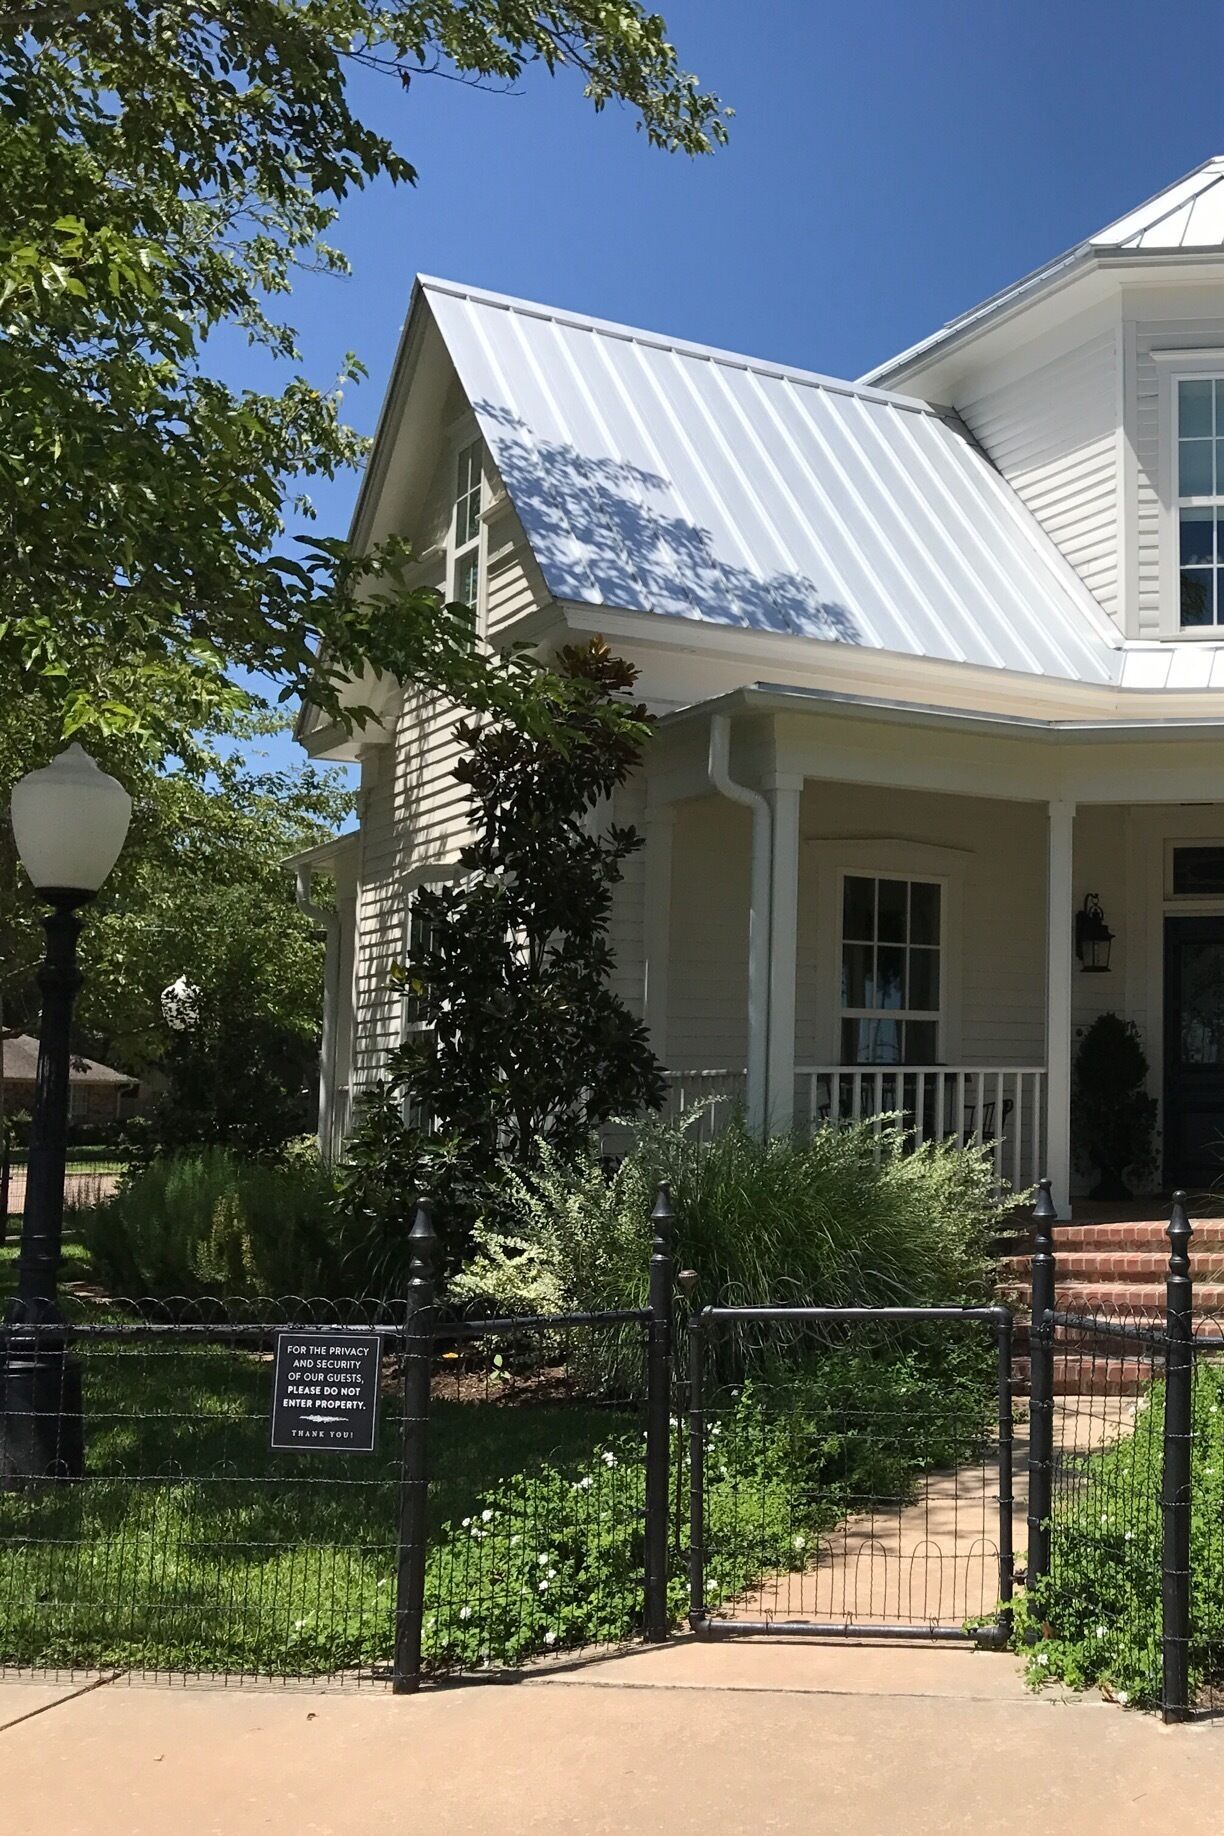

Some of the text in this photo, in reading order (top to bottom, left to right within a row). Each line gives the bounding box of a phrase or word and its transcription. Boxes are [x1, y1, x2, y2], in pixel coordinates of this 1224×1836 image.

[287, 1346, 369, 1356] FOR THE PRIVACY
[293, 1360, 361, 1369] AND SECURITY
[288, 1372, 364, 1384] OF OUR GUESTS,
[288, 1386, 360, 1396] PLEASE DO NOT
[283, 1399, 366, 1410] ENTER PROPERTY.
